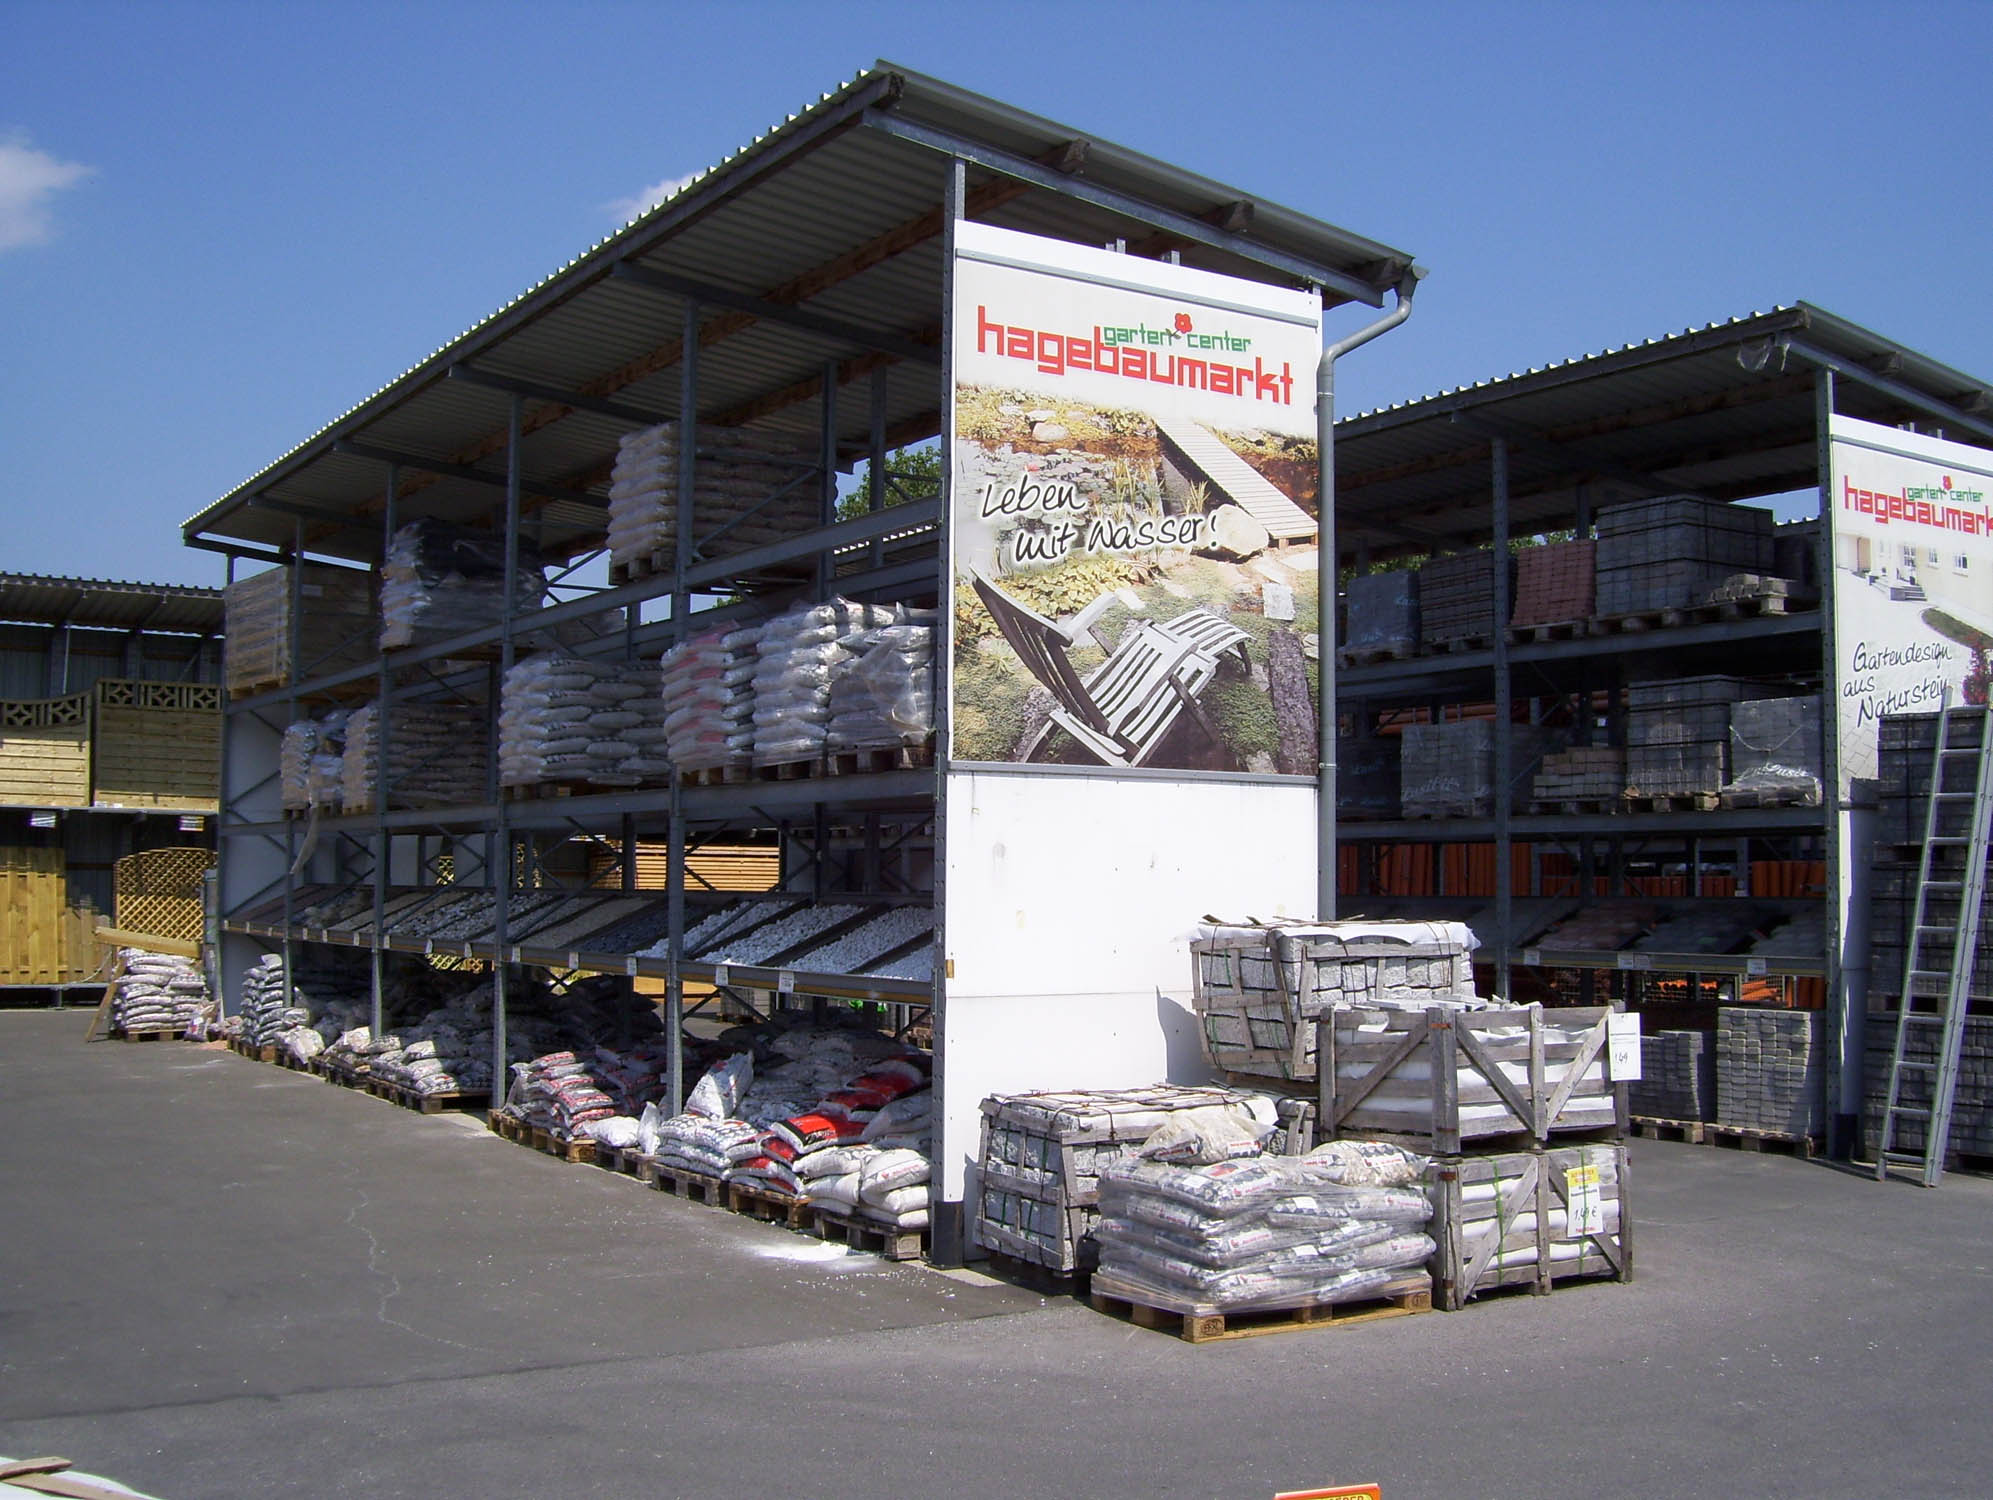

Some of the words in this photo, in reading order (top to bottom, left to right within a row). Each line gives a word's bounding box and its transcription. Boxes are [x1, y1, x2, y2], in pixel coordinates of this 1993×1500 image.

[1103, 322, 1172, 346] garten
[1187, 330, 1252, 352] center
[977, 305, 1294, 405] hagebaumarkt
[981, 473, 1086, 518] Leben
[1906, 482, 1944, 501] garten
[1949, 486, 1984, 502] center
[1014, 522, 1078, 562] mit
[1087, 514, 1219, 552] Wasser!
[1853, 641, 1953, 673] Gartendesign
[1843, 676, 1876, 697] aus
